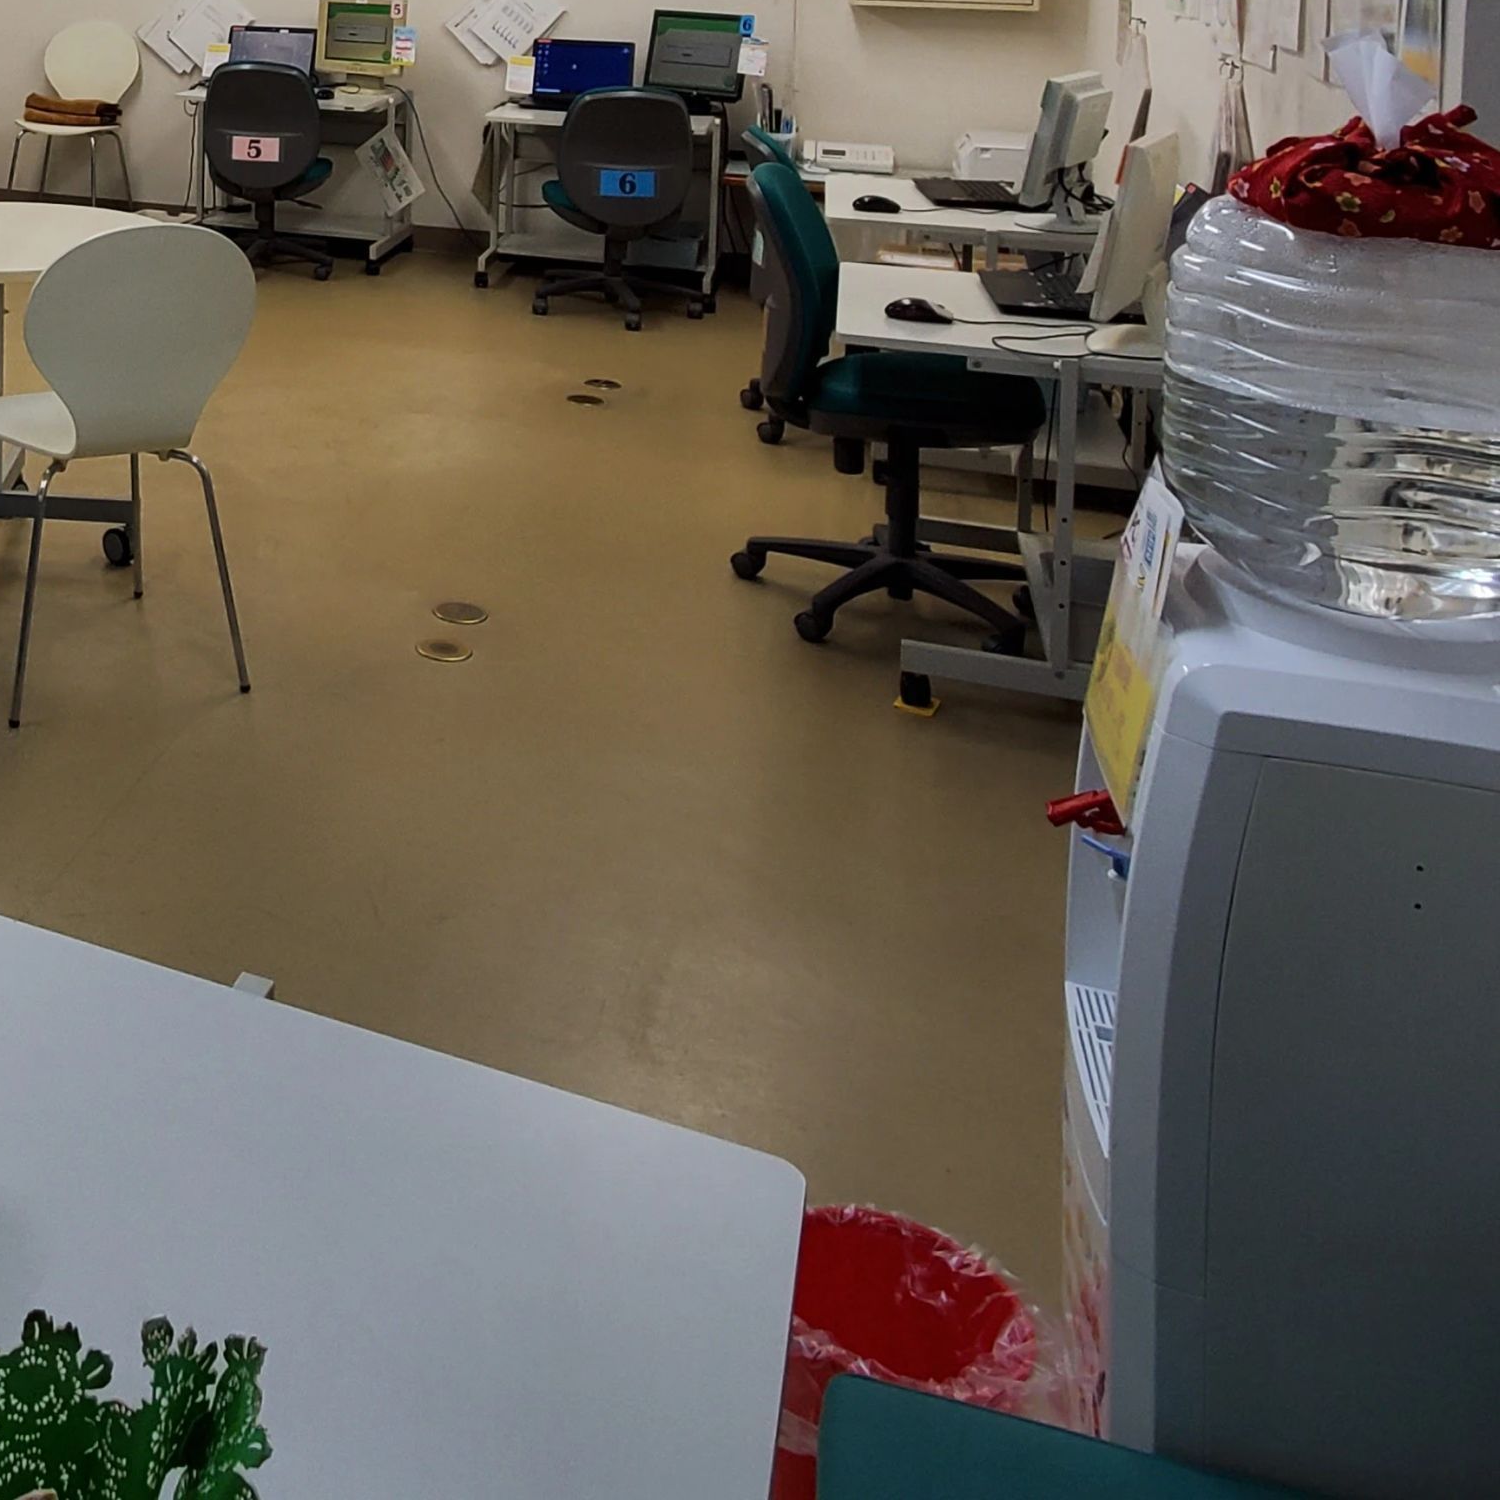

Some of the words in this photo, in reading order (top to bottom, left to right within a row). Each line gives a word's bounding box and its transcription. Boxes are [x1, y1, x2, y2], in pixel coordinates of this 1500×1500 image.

[393, 3, 401, 15] 5
[742, 18, 752, 31] 6
[246, 140, 262, 159] 5
[619, 174, 637, 195] 6
